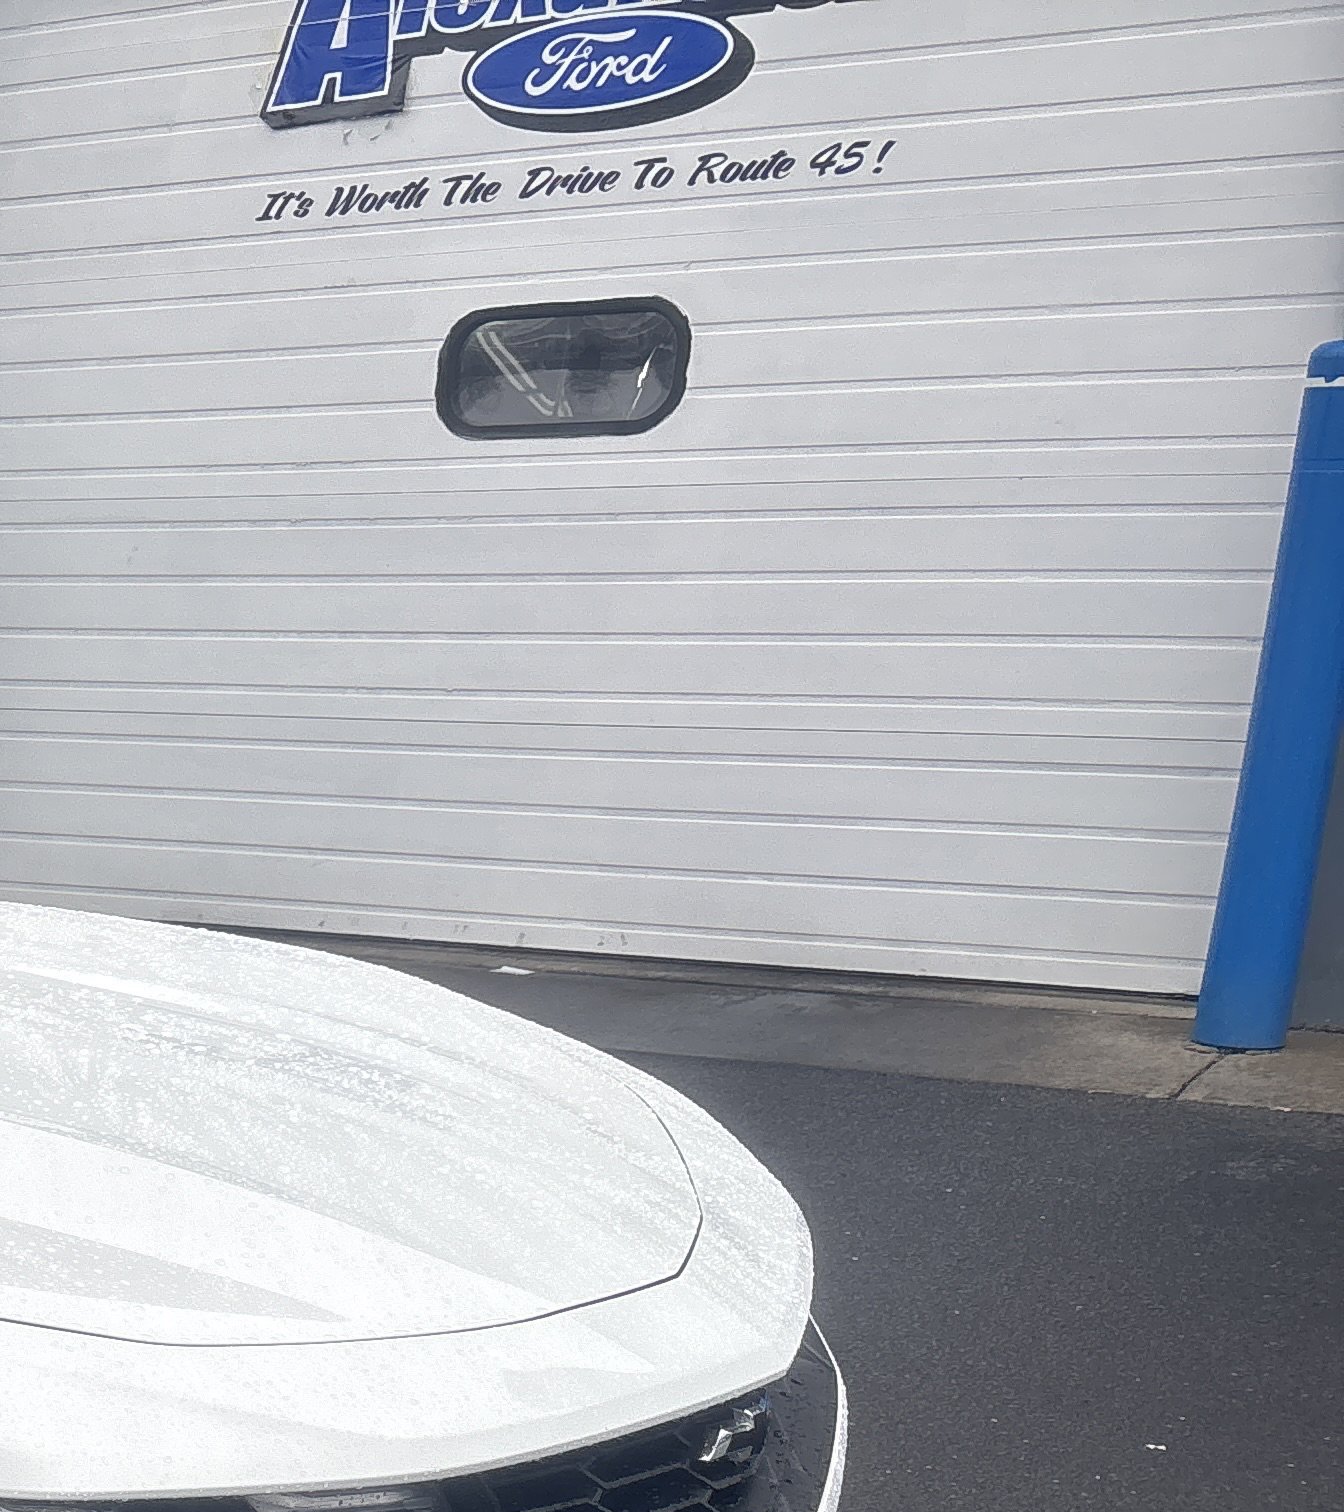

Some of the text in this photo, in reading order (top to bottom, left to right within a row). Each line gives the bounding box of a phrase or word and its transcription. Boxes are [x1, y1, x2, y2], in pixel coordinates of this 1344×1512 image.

[524, 28, 673, 96] Ford
[256, 191, 314, 221] It's
[325, 176, 430, 217] Worth
[442, 171, 503, 207] The
[518, 165, 621, 200] Drive
[633, 156, 675, 190] To
[687, 149, 796, 187] Route
